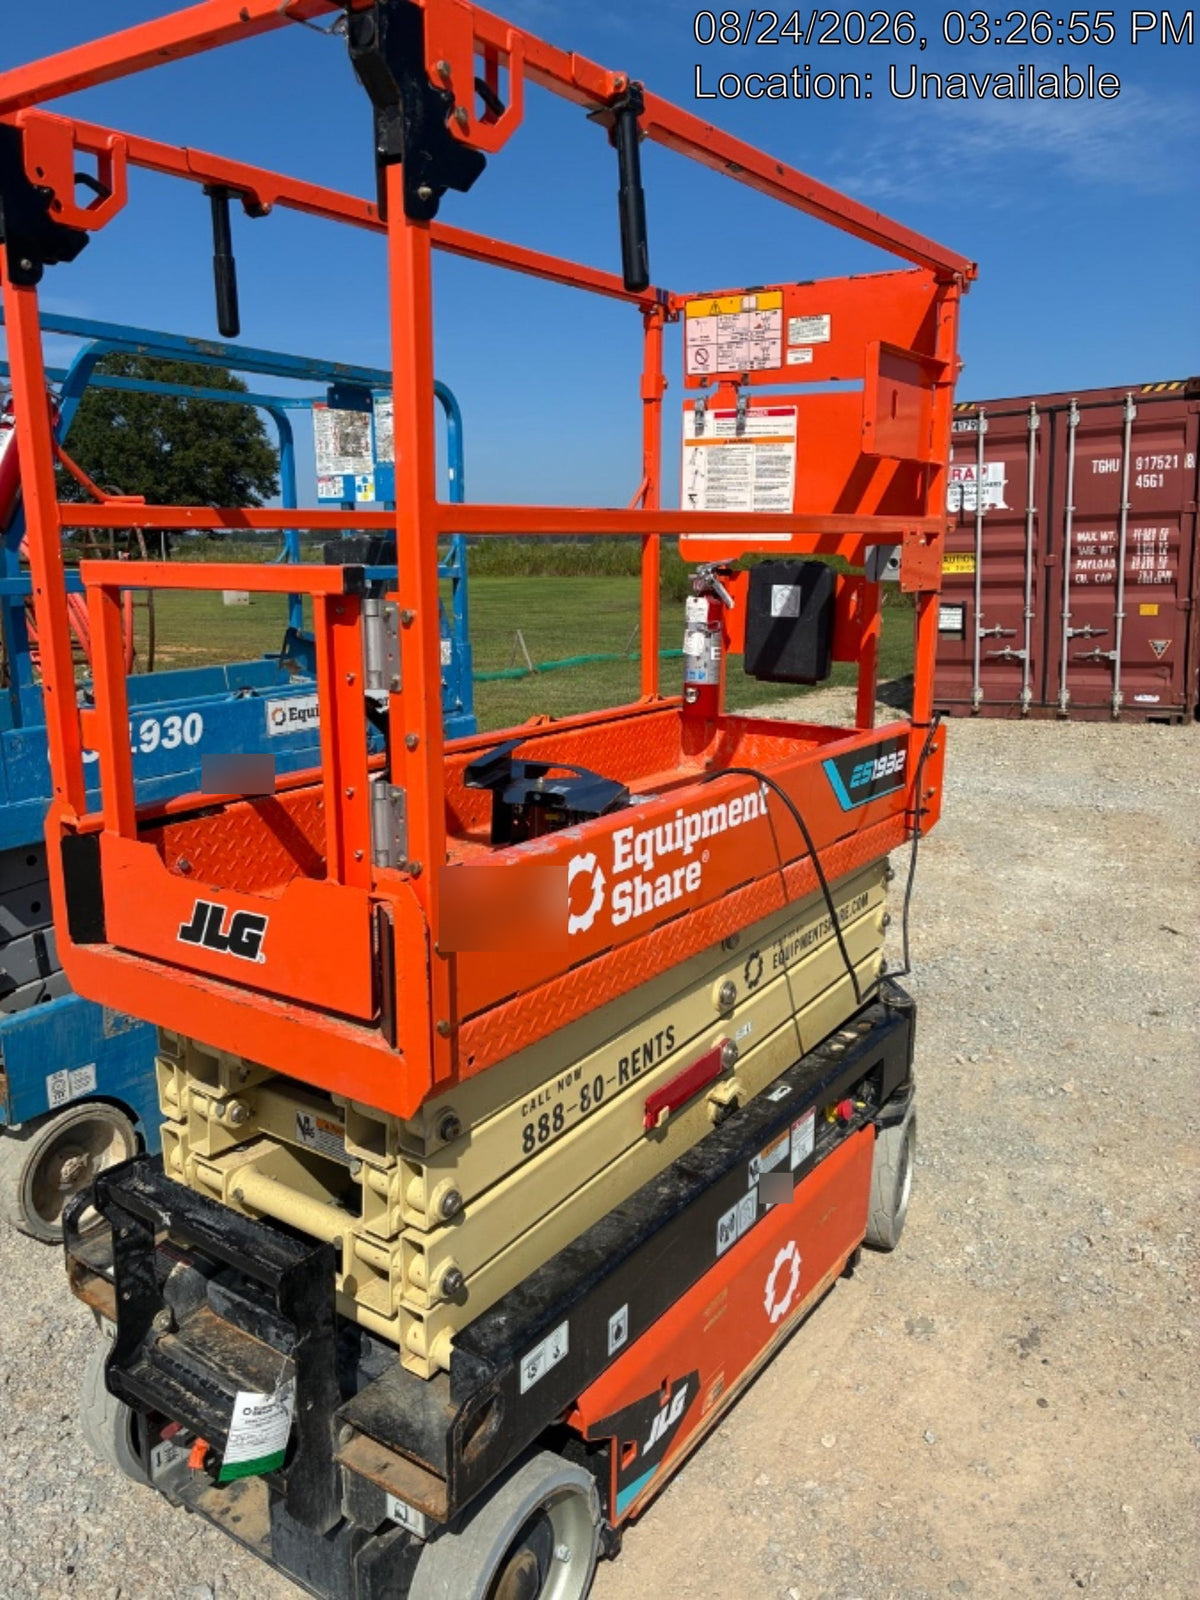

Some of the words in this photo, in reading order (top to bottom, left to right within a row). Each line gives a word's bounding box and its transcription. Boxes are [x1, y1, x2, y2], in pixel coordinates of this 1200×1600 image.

[1092, 458, 1120, 474] TGHU
[1135, 454, 1178, 470] 917521
[289, 704, 320, 722] Equi
[612, 781, 768, 875] Equipment
[177, 898, 269, 964] JLG
[521, 1090, 551, 1117] CALL
[557, 1066, 582, 1093] NOW
[522, 1024, 675, 1154] 888-80-RENTS
[642, 1383, 688, 1456] JLG
